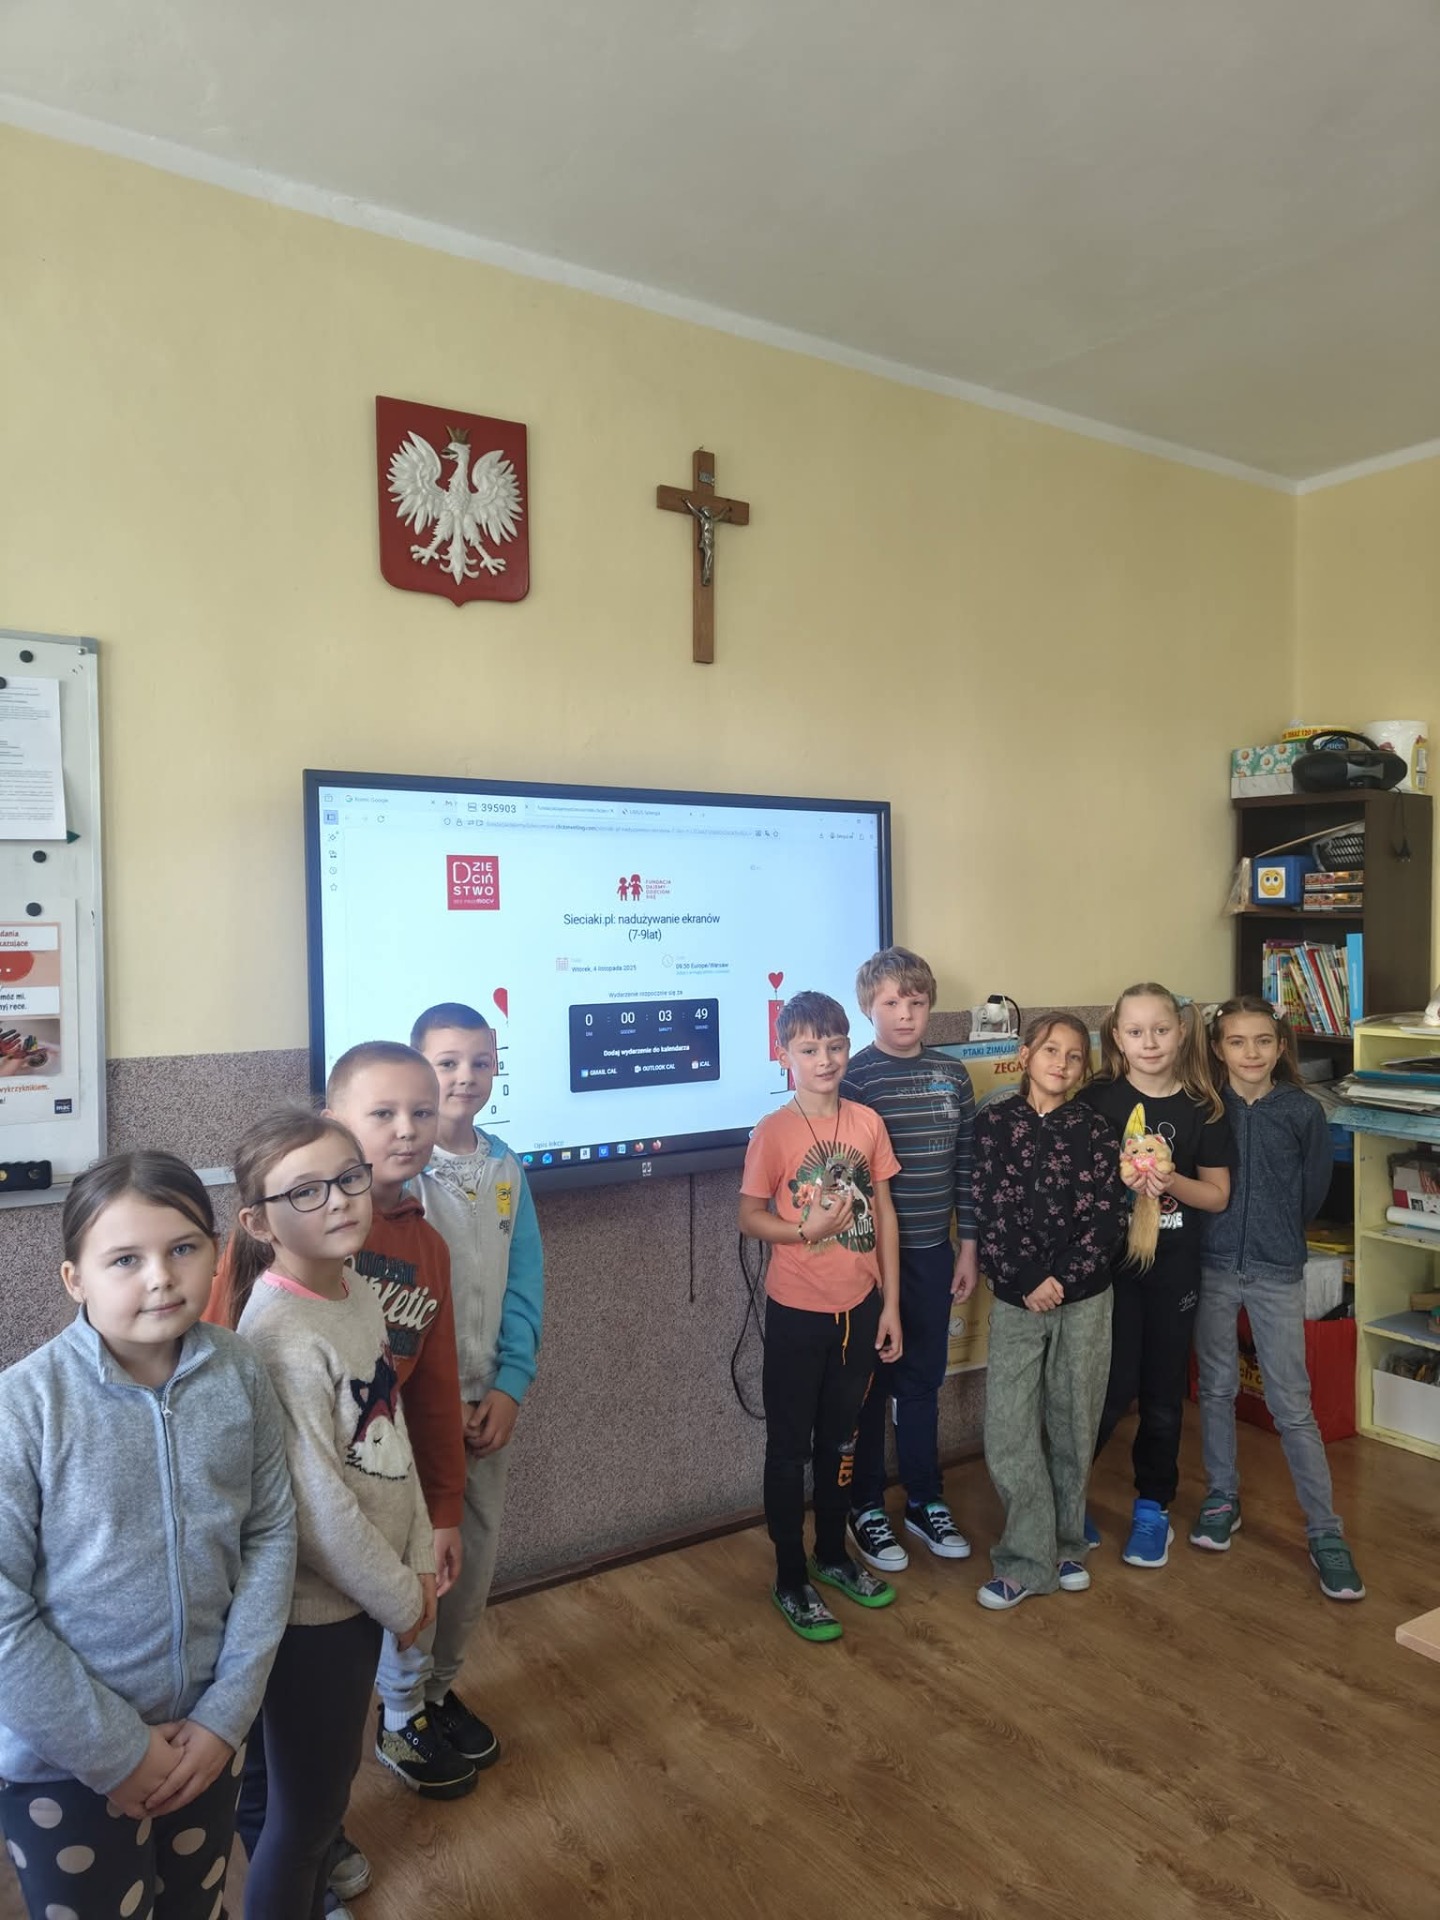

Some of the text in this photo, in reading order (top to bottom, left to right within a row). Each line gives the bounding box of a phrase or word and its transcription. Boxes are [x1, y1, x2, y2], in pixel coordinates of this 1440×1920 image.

[481, 803, 517, 814] 395903
[453, 886, 494, 896] STWO
[563, 913, 720, 926] Sieciaki.pl: nadużywanie ekranów
[628, 929, 662, 942] (7-9lat)
[608, 990, 639, 998] Wydarzenie
[585, 1007, 708, 1026] 0 00 03 49
[603, 1049, 620, 1057] Dodaj
[620, 1047, 652, 1056] wydarzenie
[661, 1044, 690, 1053] kalendarza
[963, 1047, 984, 1057] PTAKI
[994, 1061, 1023, 1075] ZEGA
